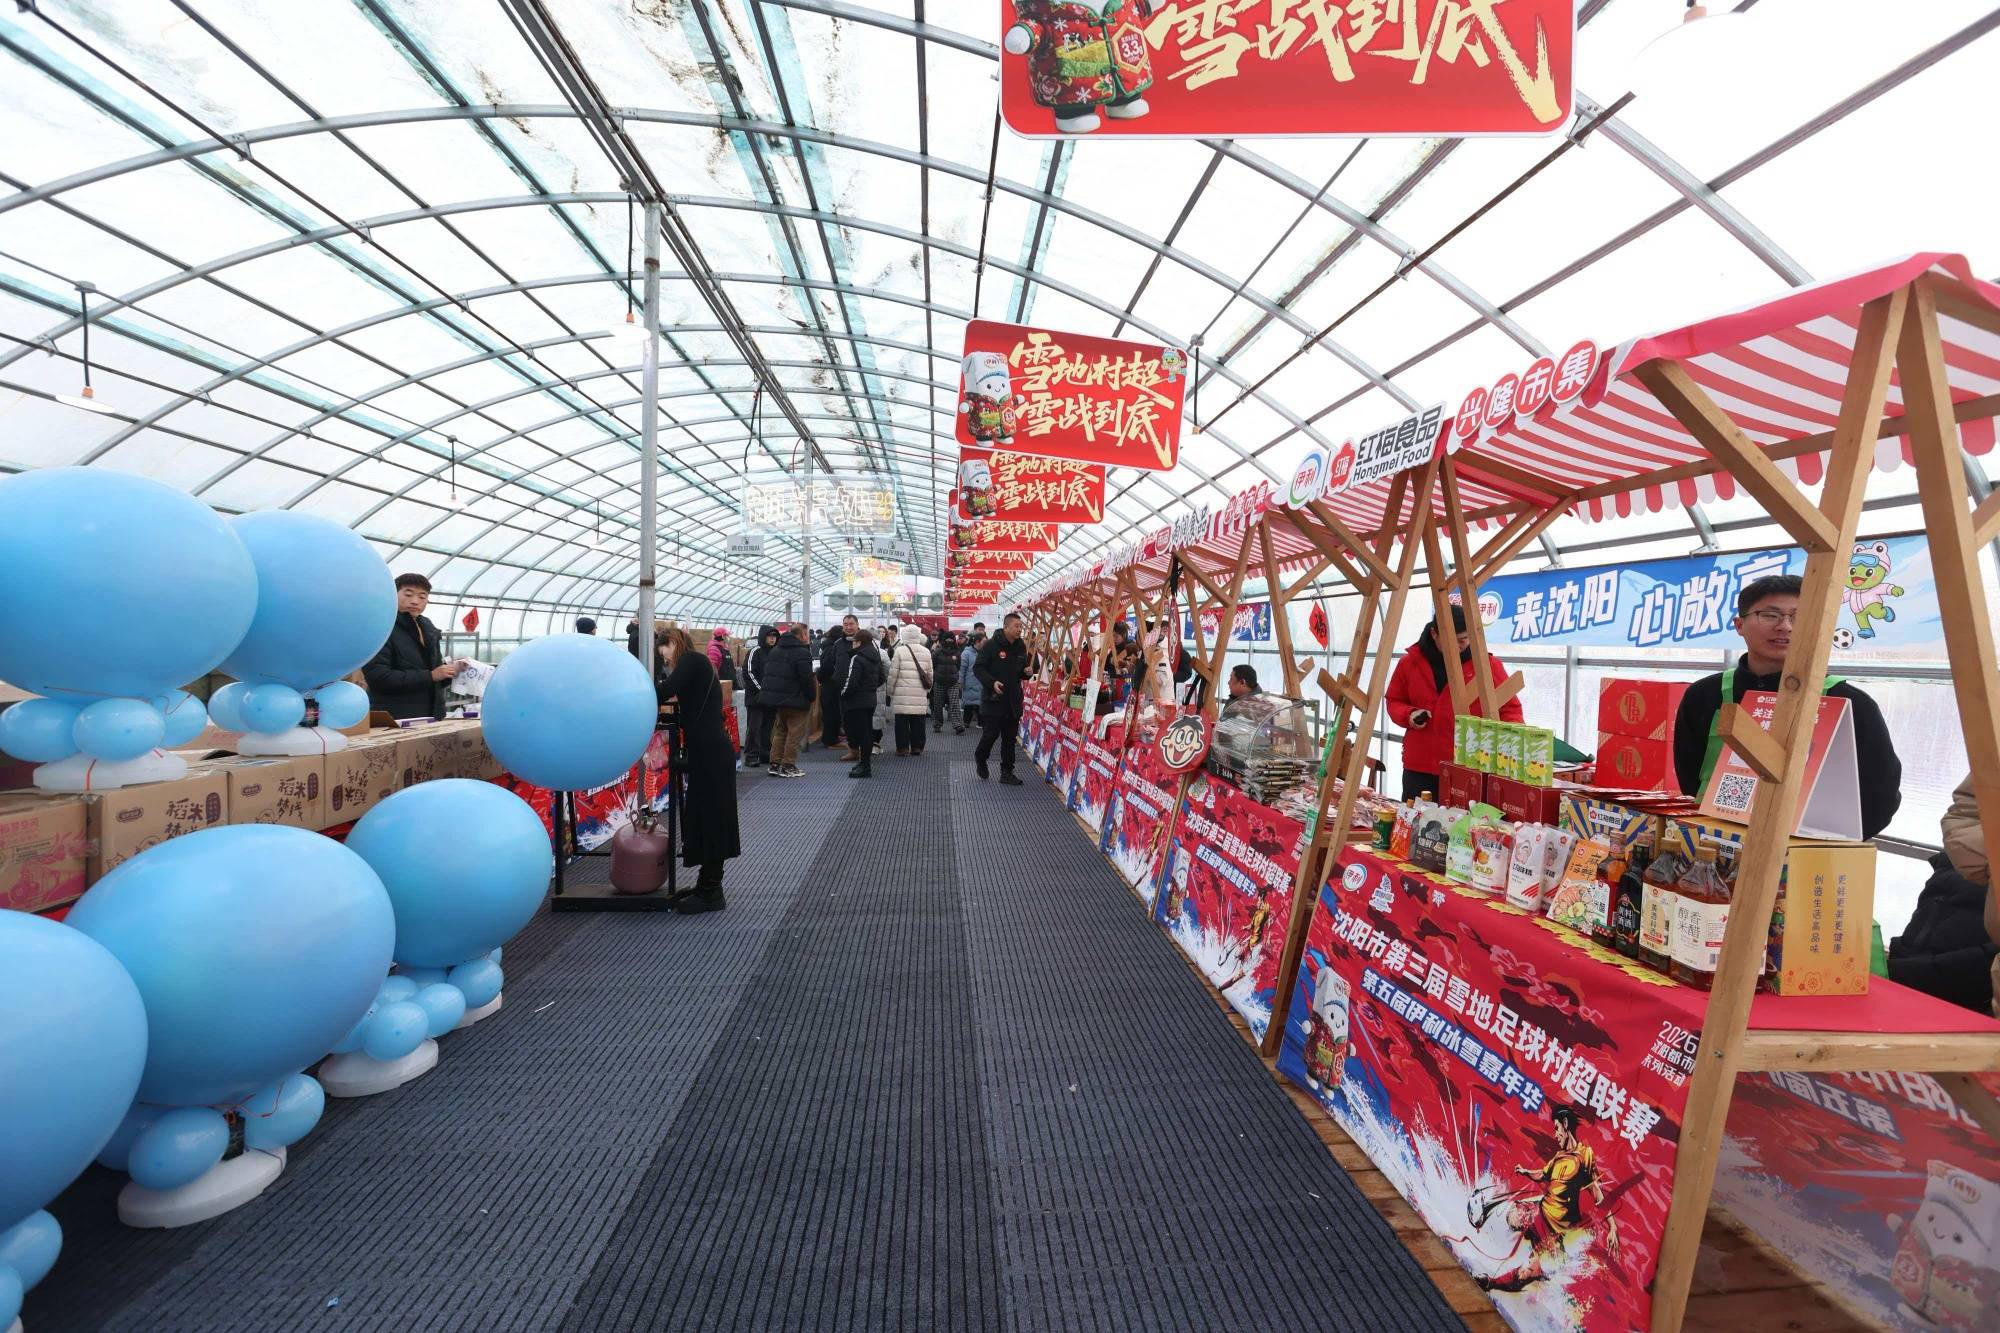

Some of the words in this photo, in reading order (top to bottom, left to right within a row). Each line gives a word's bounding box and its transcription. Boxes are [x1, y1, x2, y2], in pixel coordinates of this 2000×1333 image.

[1008, 333, 1175, 410] 雪地村超
[1458, 347, 1592, 433] 兴隆市集
[1015, 392, 1173, 468] 雪战到底
[1356, 404, 1442, 466] 红梅食品
[1295, 466, 1316, 490] 伊利
[1353, 459, 1400, 482] Hongmei
[1401, 444, 1431, 467] Food
[994, 475, 1101, 522] 雪战到底
[1513, 570, 1620, 641] 来沈阳
[1752, 707, 1774, 719] 关注
[1346, 869, 1362, 885] 伊利
[1331, 909, 1661, 1151] 沈阳市第三届雪地足球村超联赛
[1362, 969, 1544, 1111] 第五届伊利冰雪嘉年华
[1658, 1020, 1700, 1055] 2026
[1641, 1053, 1687, 1087] 系列活动
